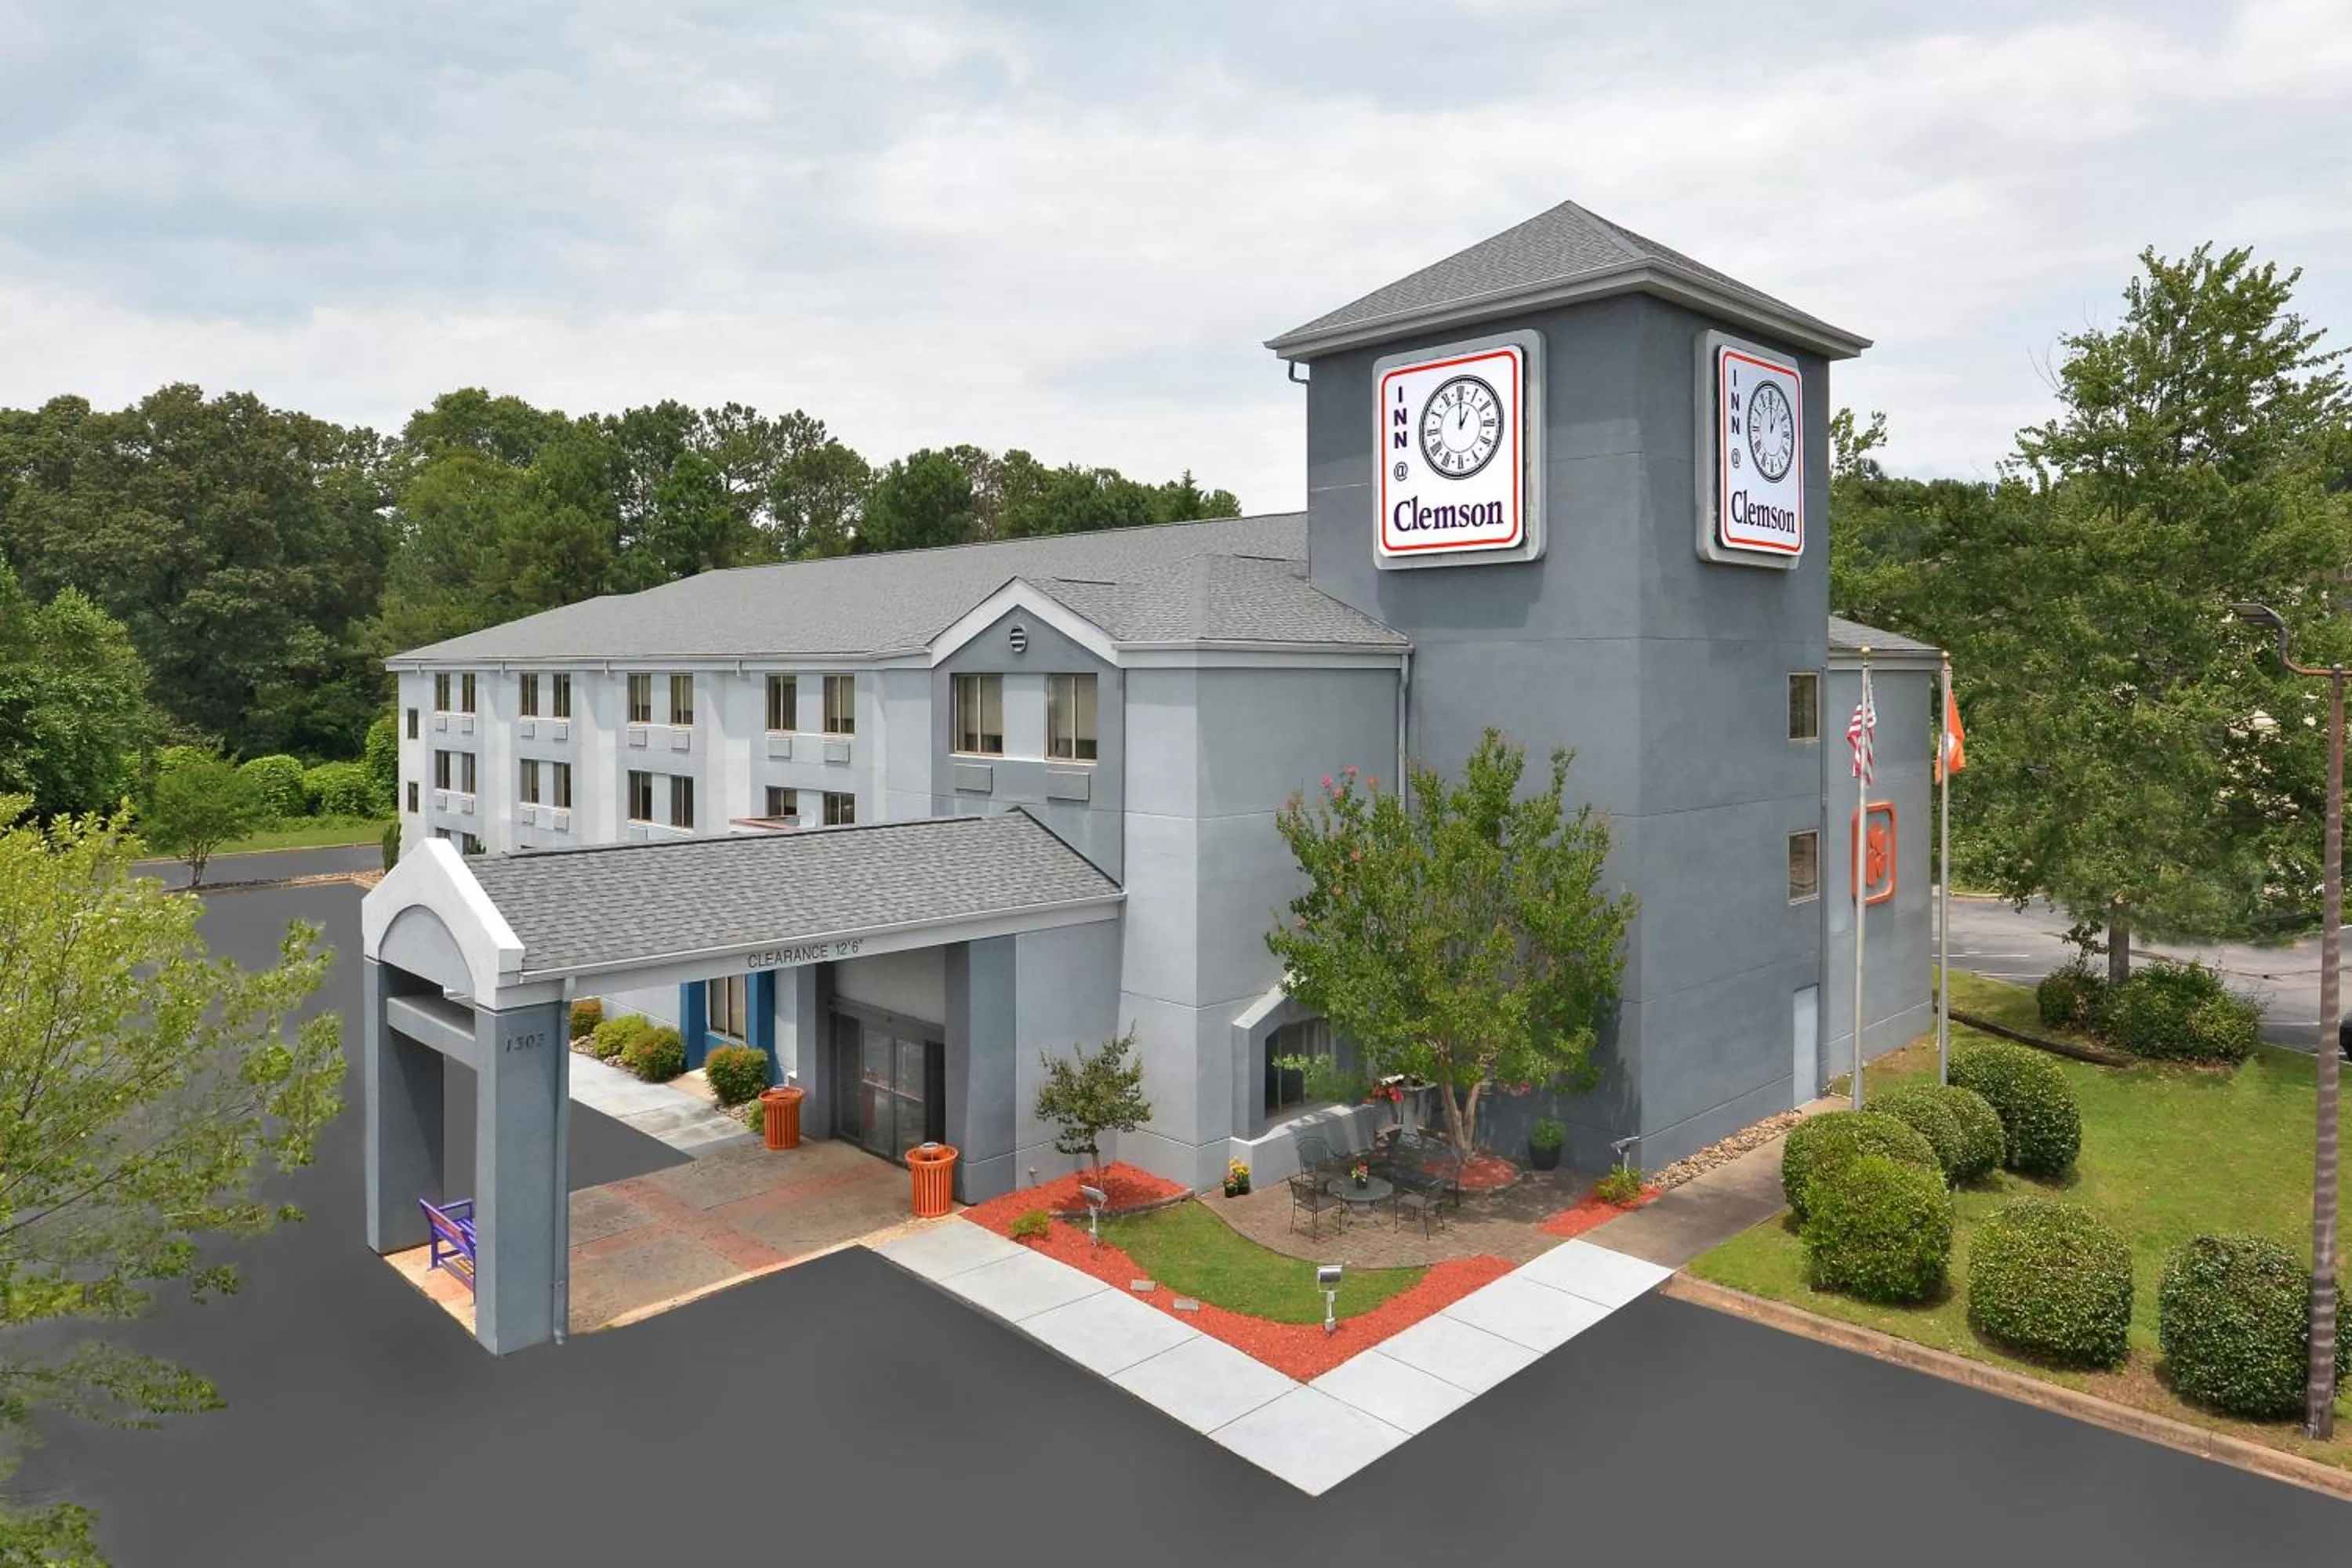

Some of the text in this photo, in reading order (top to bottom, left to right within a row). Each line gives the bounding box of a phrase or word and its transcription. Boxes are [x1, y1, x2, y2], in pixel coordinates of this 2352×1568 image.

[1730, 369, 1740, 435] INN
[1393, 387, 1409, 481] INN @
[1393, 495, 1504, 532] Clemson
[1731, 489, 1795, 533] Clemson
[747, 944, 829, 969] CLEARANCE
